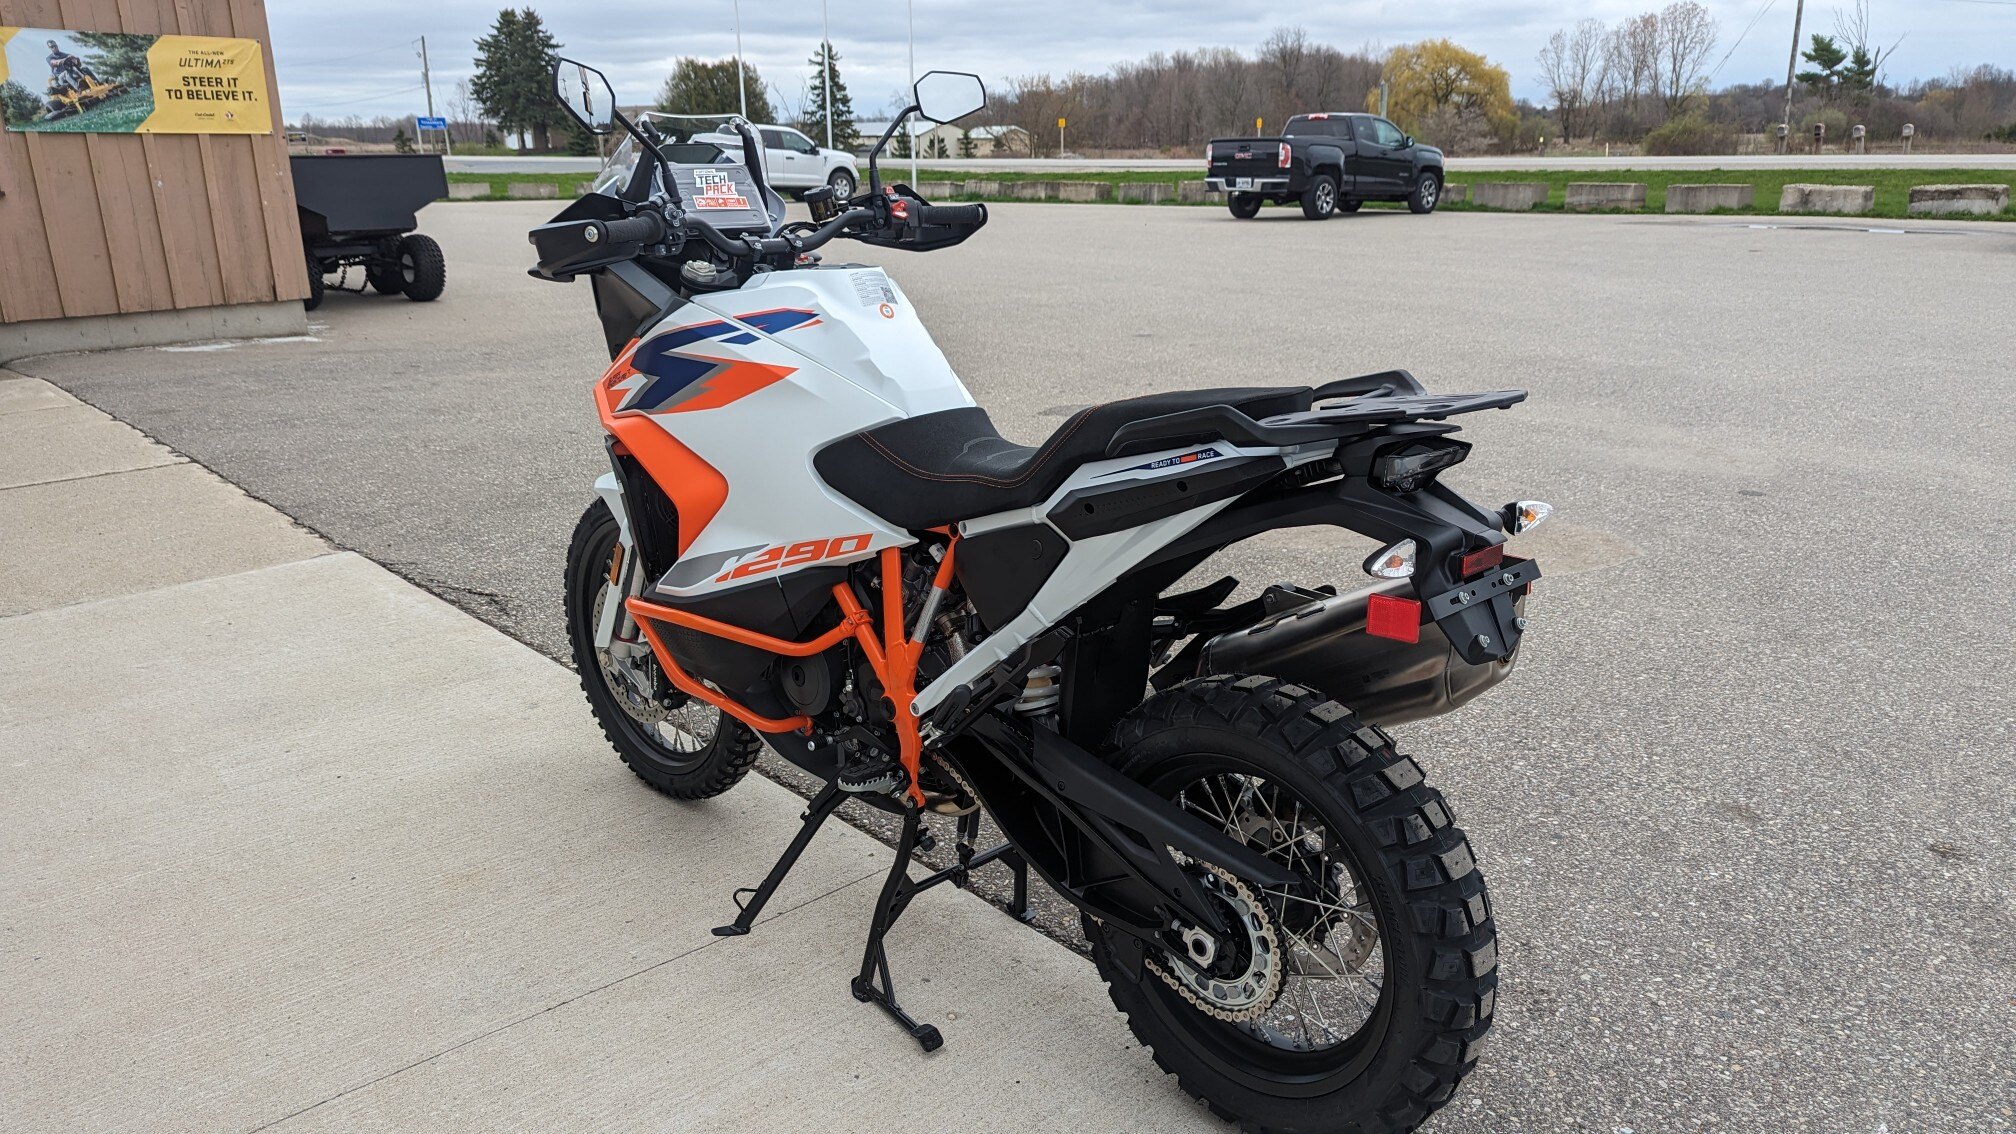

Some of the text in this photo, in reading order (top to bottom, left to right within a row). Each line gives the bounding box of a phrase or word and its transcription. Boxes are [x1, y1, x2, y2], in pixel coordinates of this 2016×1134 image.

[179, 57, 222, 69] ULTIMA
[182, 75, 239, 88] STEER IT
[165, 88, 258, 102] TO BELIEVE IT.
[698, 175, 727, 186] TECH
[706, 184, 734, 195] PACK
[1151, 460, 1171, 469] READY
[1197, 450, 1215, 460] RACE
